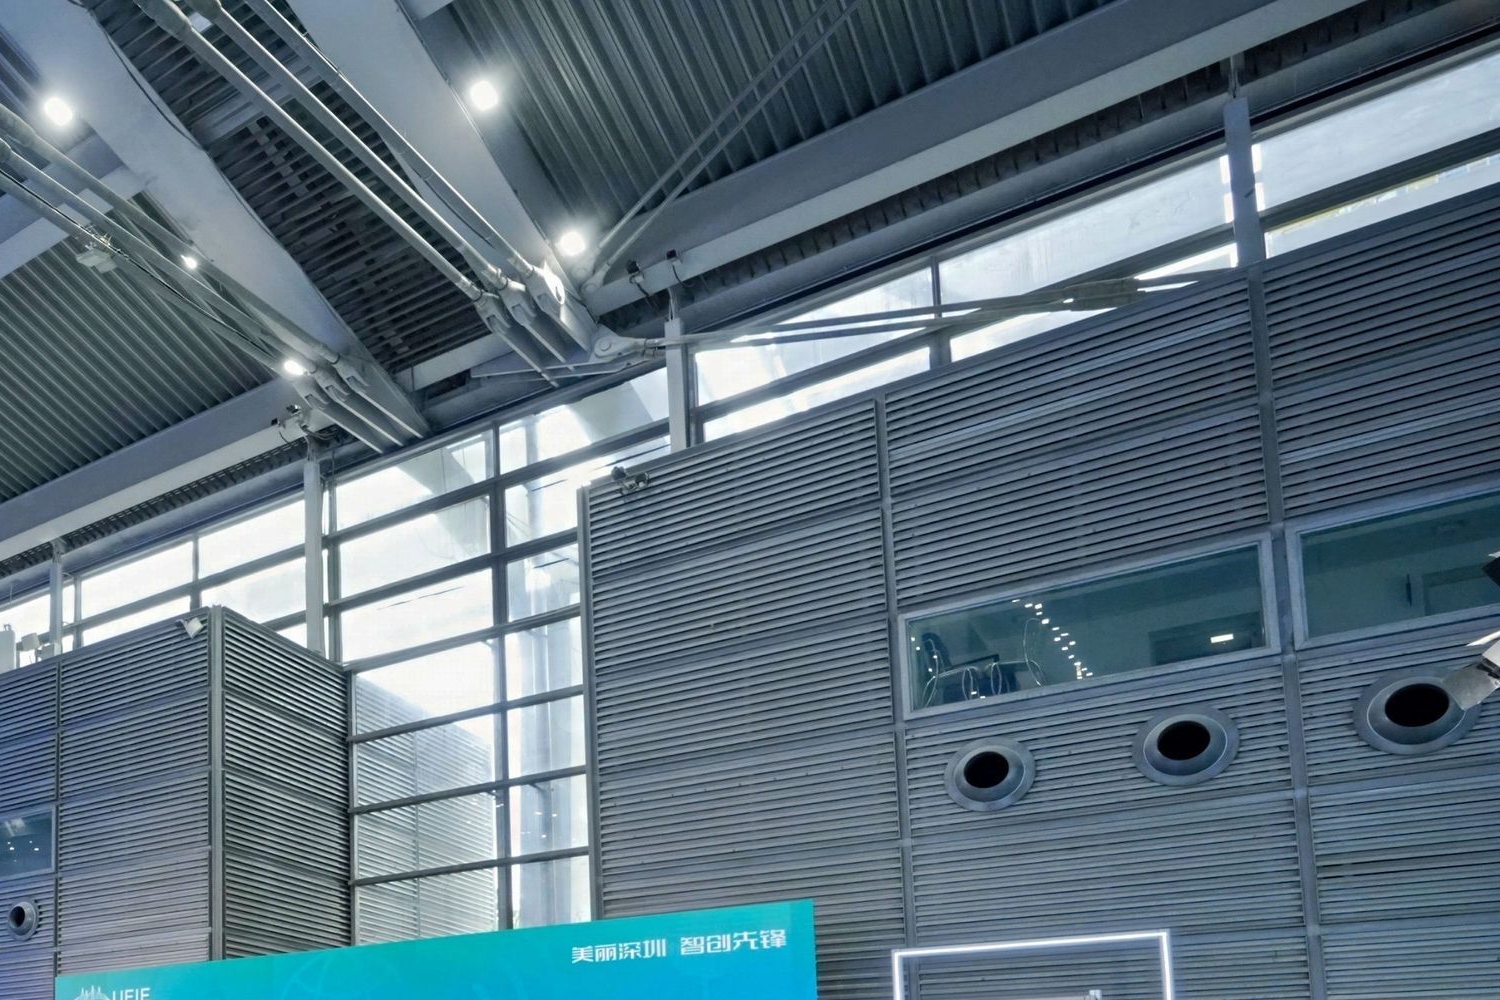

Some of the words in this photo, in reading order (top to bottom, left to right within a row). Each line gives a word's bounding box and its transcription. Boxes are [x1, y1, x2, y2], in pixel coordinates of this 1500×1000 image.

[572, 939, 667, 964] 美丽深圳
[680, 929, 787, 956] 智创先锋
